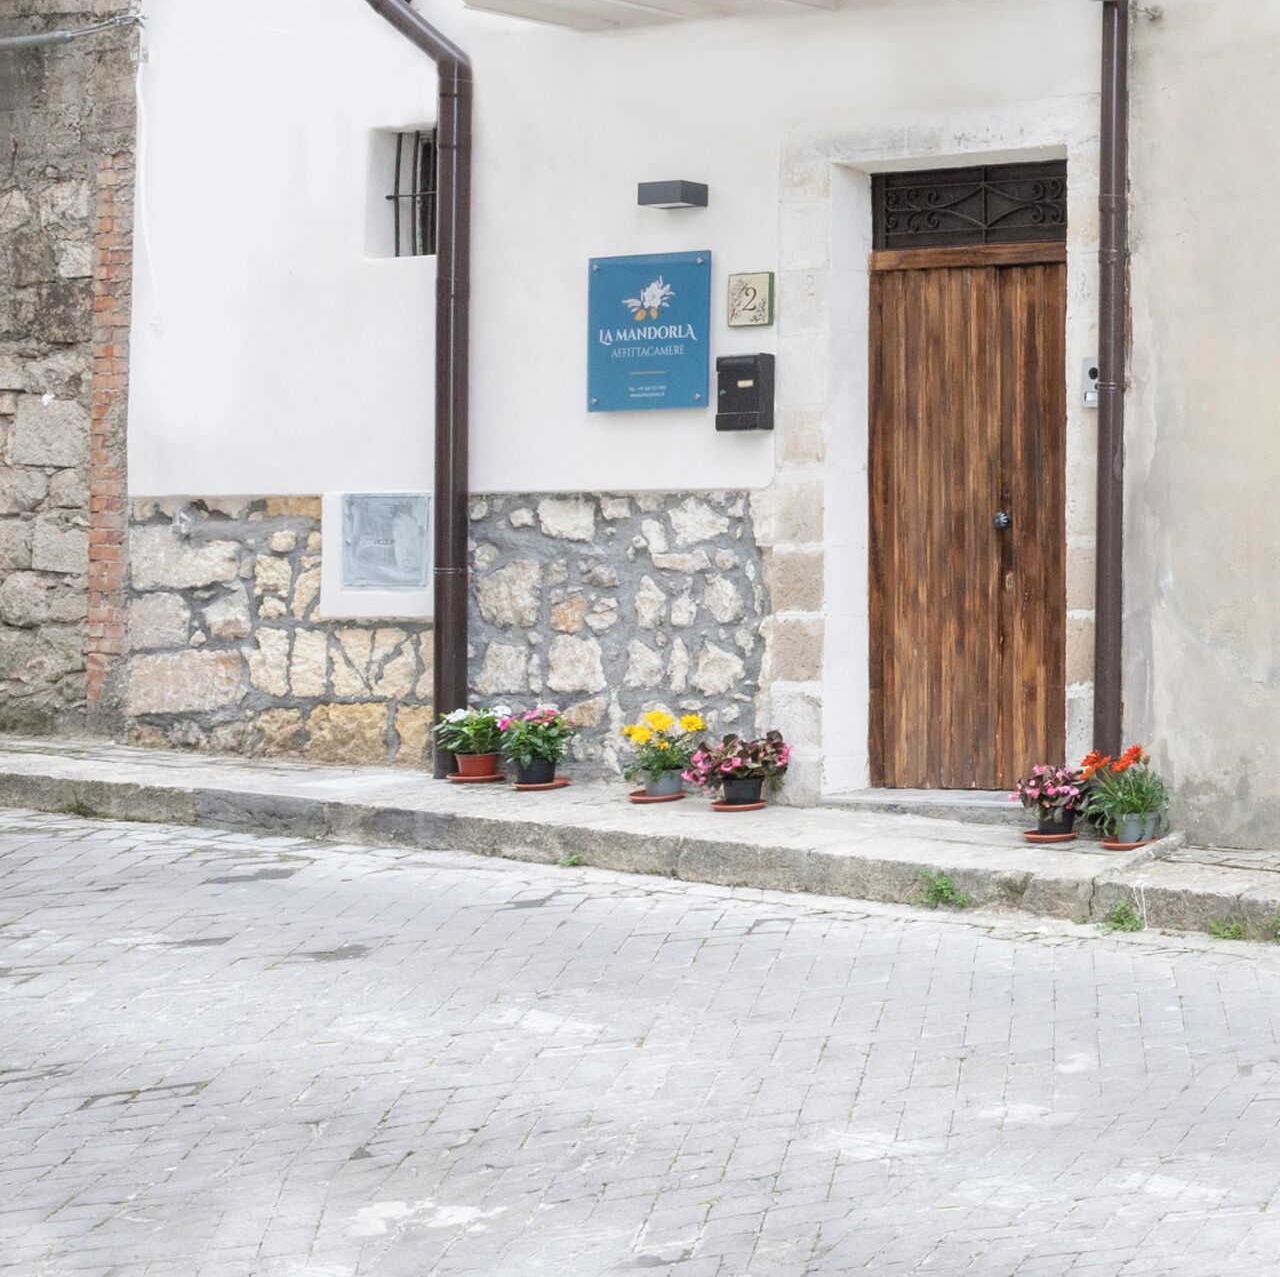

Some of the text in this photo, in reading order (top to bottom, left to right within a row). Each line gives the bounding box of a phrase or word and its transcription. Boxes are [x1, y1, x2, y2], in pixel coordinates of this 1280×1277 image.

[742, 286, 757, 312] 2
[599, 323, 698, 346] LA MANDORLA
[611, 344, 685, 358] AFFITTACAMERE
